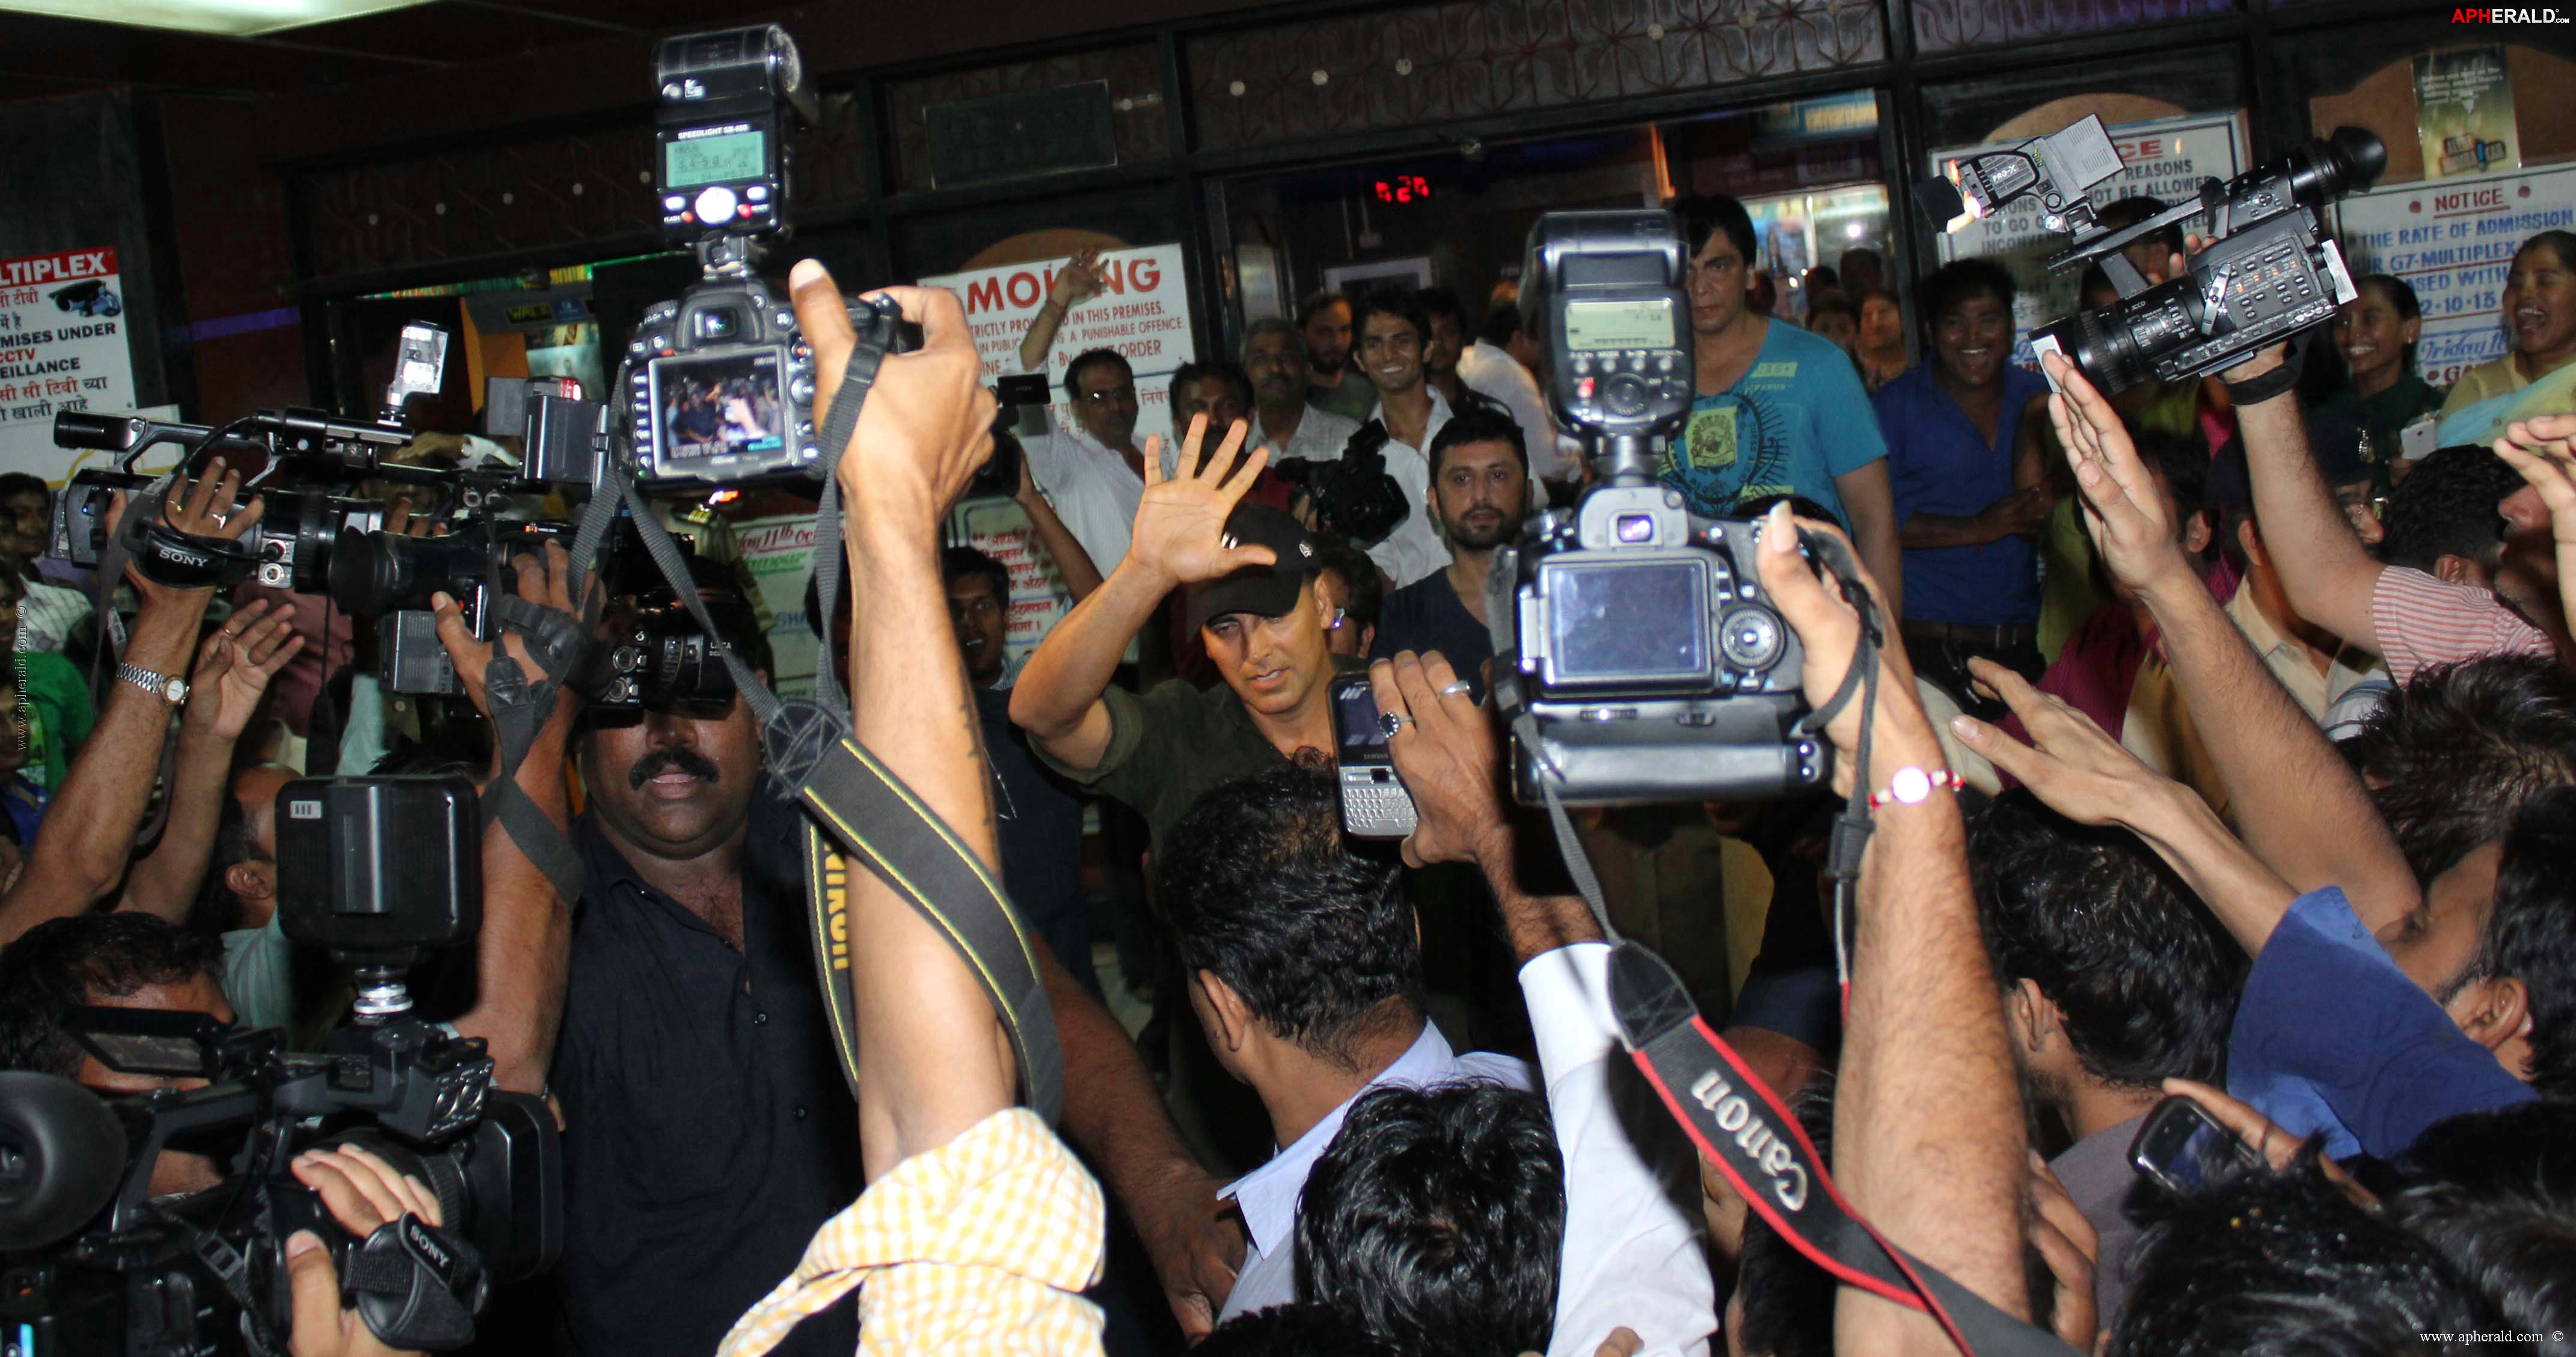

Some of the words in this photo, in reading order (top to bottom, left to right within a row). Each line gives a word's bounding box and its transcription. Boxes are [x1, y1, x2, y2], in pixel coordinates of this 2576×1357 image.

[678, 126, 722, 140] SPEEDLIGHT
[2125, 159, 2194, 180] REASONS
[2120, 183, 2138, 199] BE
[2435, 188, 2504, 212] NOTICE
[1983, 221, 2002, 235] TO
[2399, 225, 2445, 245] RATE
[2449, 222, 2473, 238] OF
[2476, 209, 2574, 236] ADMISSION
[1072, 311, 1084, 325] IN
[1087, 307, 1110, 324] THIS
[58, 322, 116, 341] UNDER
[1082, 322, 1135, 343] PUNISHABLE
[1117, 339, 1161, 359] ORDER
[159, 548, 209, 568] SONY
[1690, 1069, 1808, 1212] Canon
[410, 1224, 449, 1268] SONY
